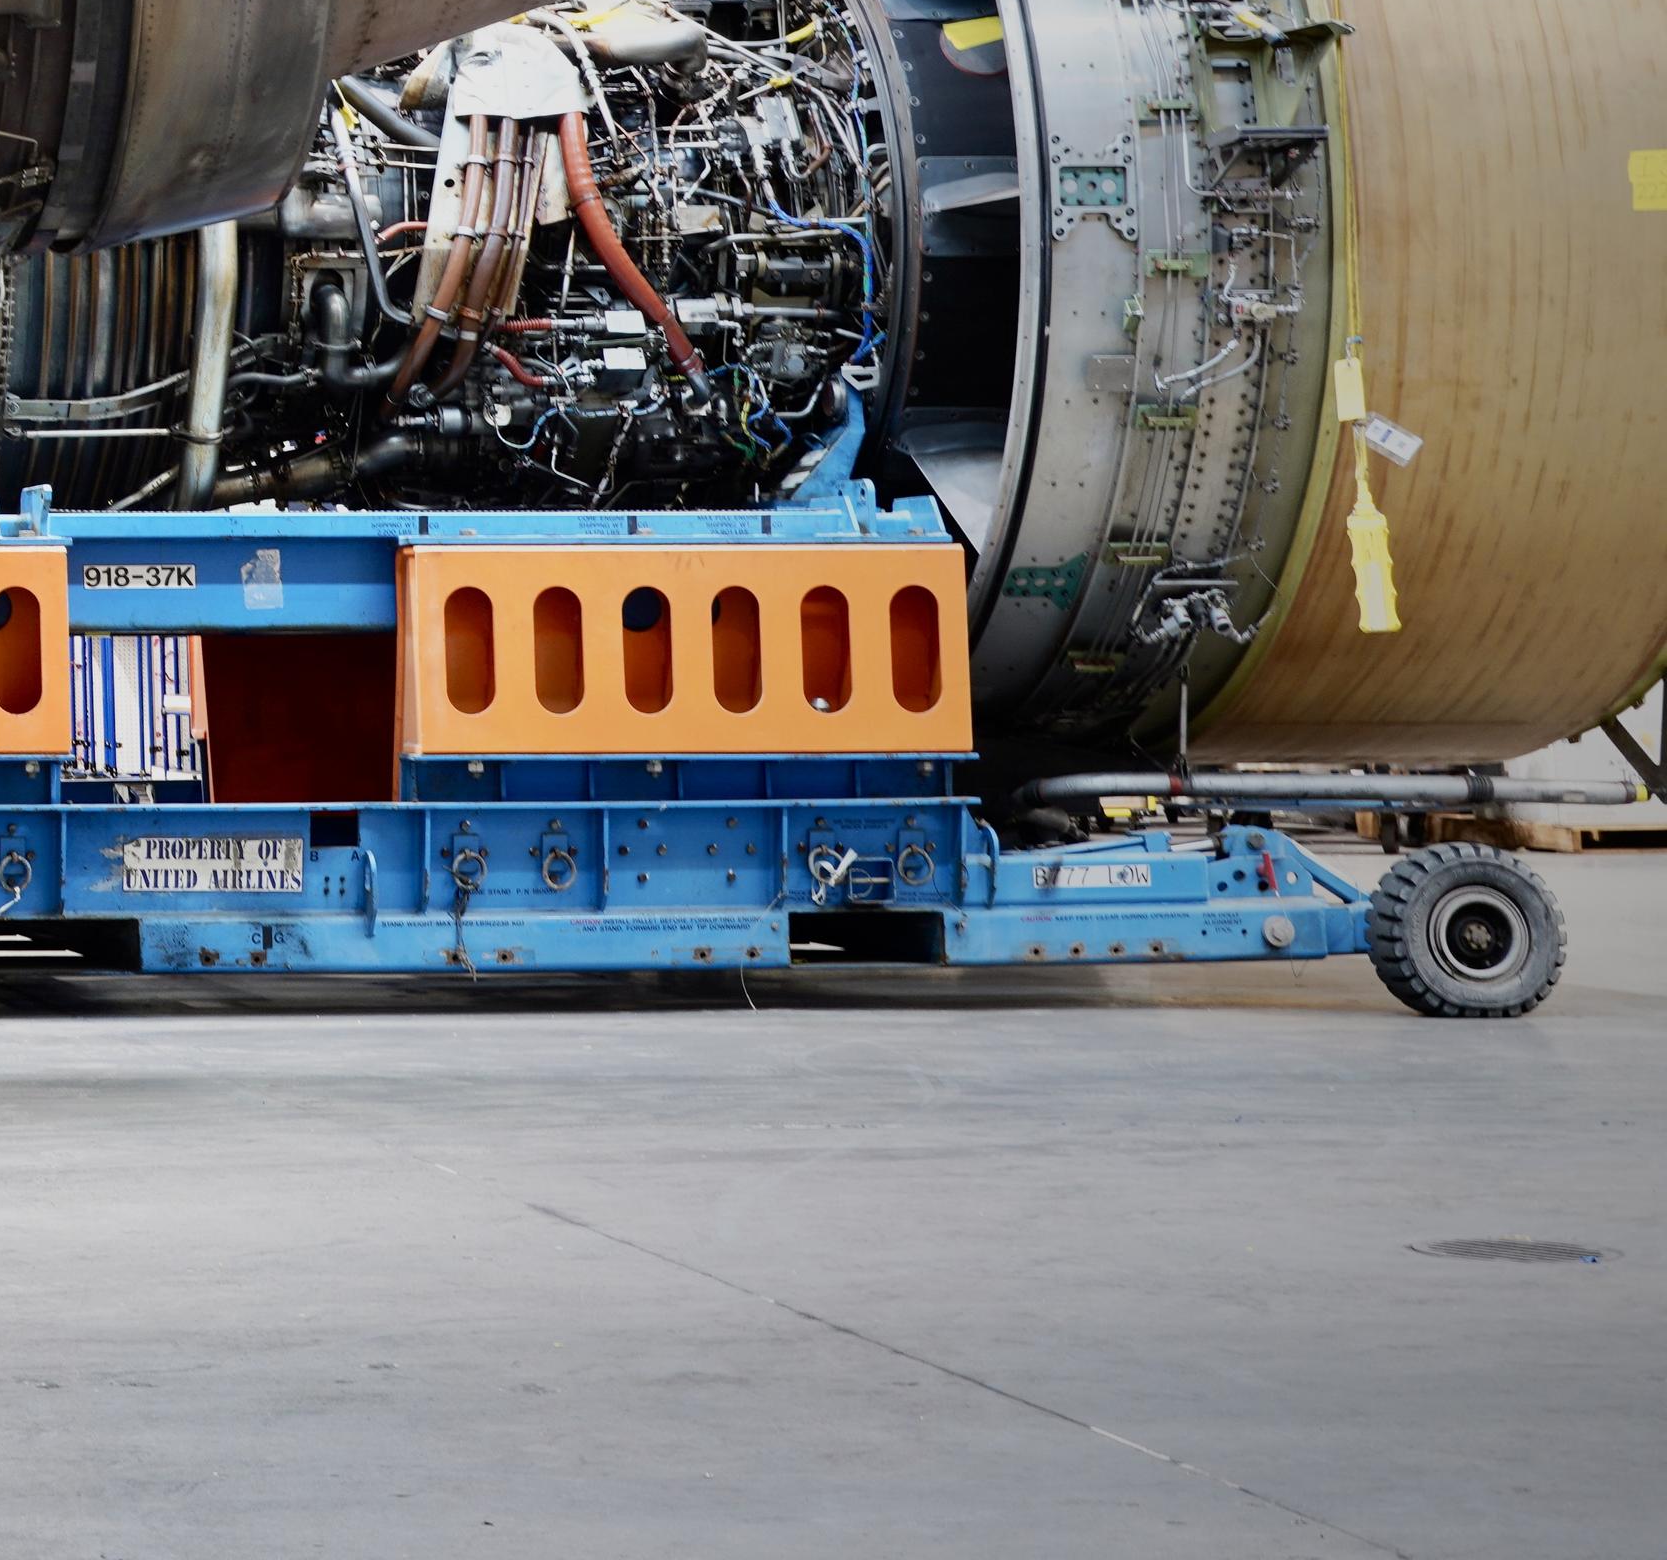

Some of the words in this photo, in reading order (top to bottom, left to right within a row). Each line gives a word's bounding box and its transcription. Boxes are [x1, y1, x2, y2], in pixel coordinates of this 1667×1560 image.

[84, 566, 194, 587] 918-37K
[145, 839, 246, 860] PROPERTY
[258, 839, 284, 861] OF
[310, 851, 319, 862] B
[351, 851, 360, 862] A
[125, 868, 198, 889] UNITED
[208, 868, 301, 889] AIRLINES
[251, 933, 261, 945] C
